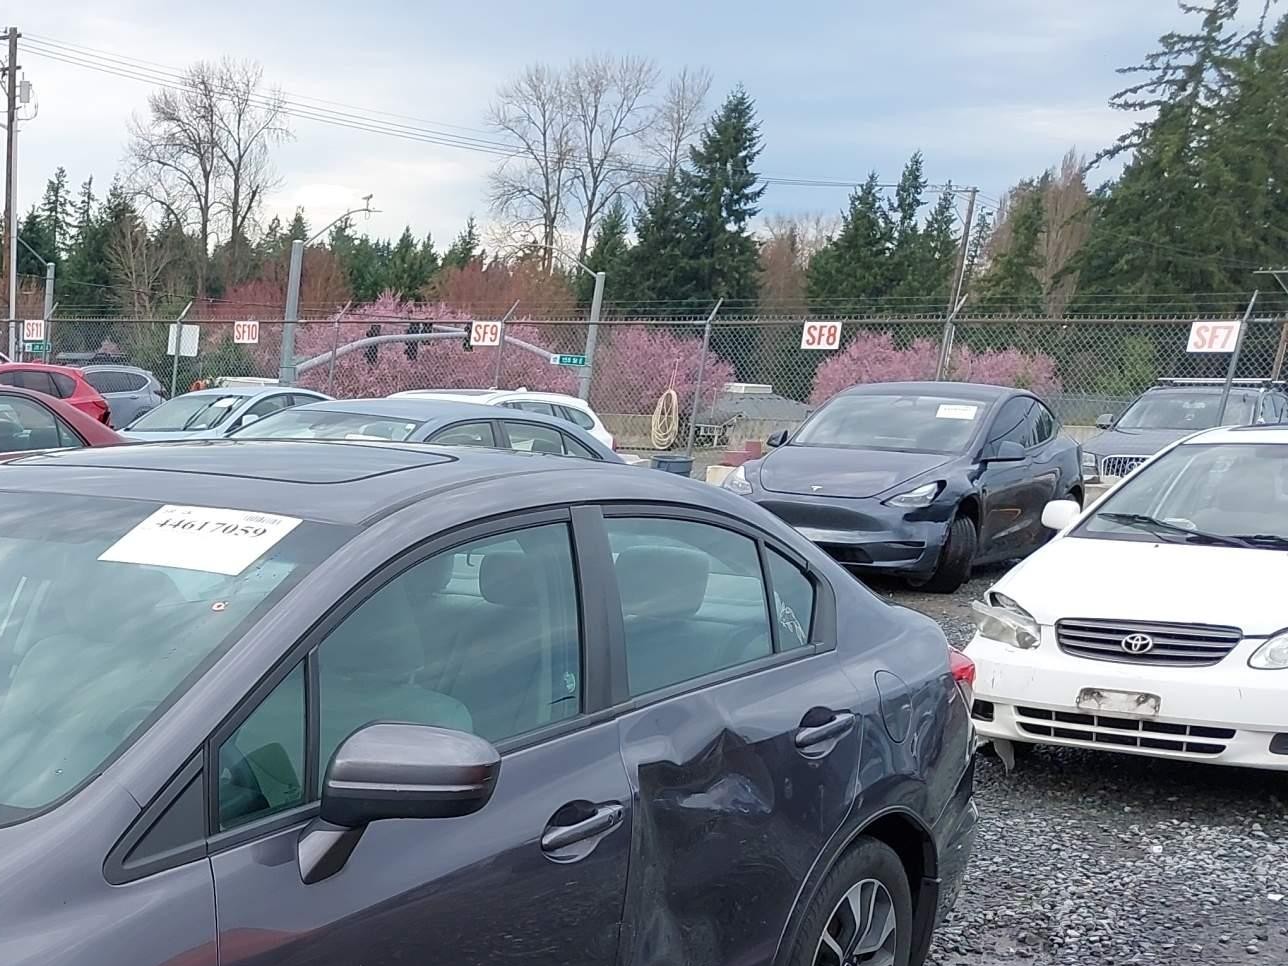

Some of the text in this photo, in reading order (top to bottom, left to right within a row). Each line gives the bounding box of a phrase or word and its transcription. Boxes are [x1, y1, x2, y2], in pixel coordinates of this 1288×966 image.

[26, 322, 42, 338] SF11
[235, 323, 258, 341] SF10
[473, 324, 499, 343] SF9
[806, 325, 838, 346] SF8
[1193, 325, 1235, 349] SF7
[156, 518, 267, 538] 44617059
